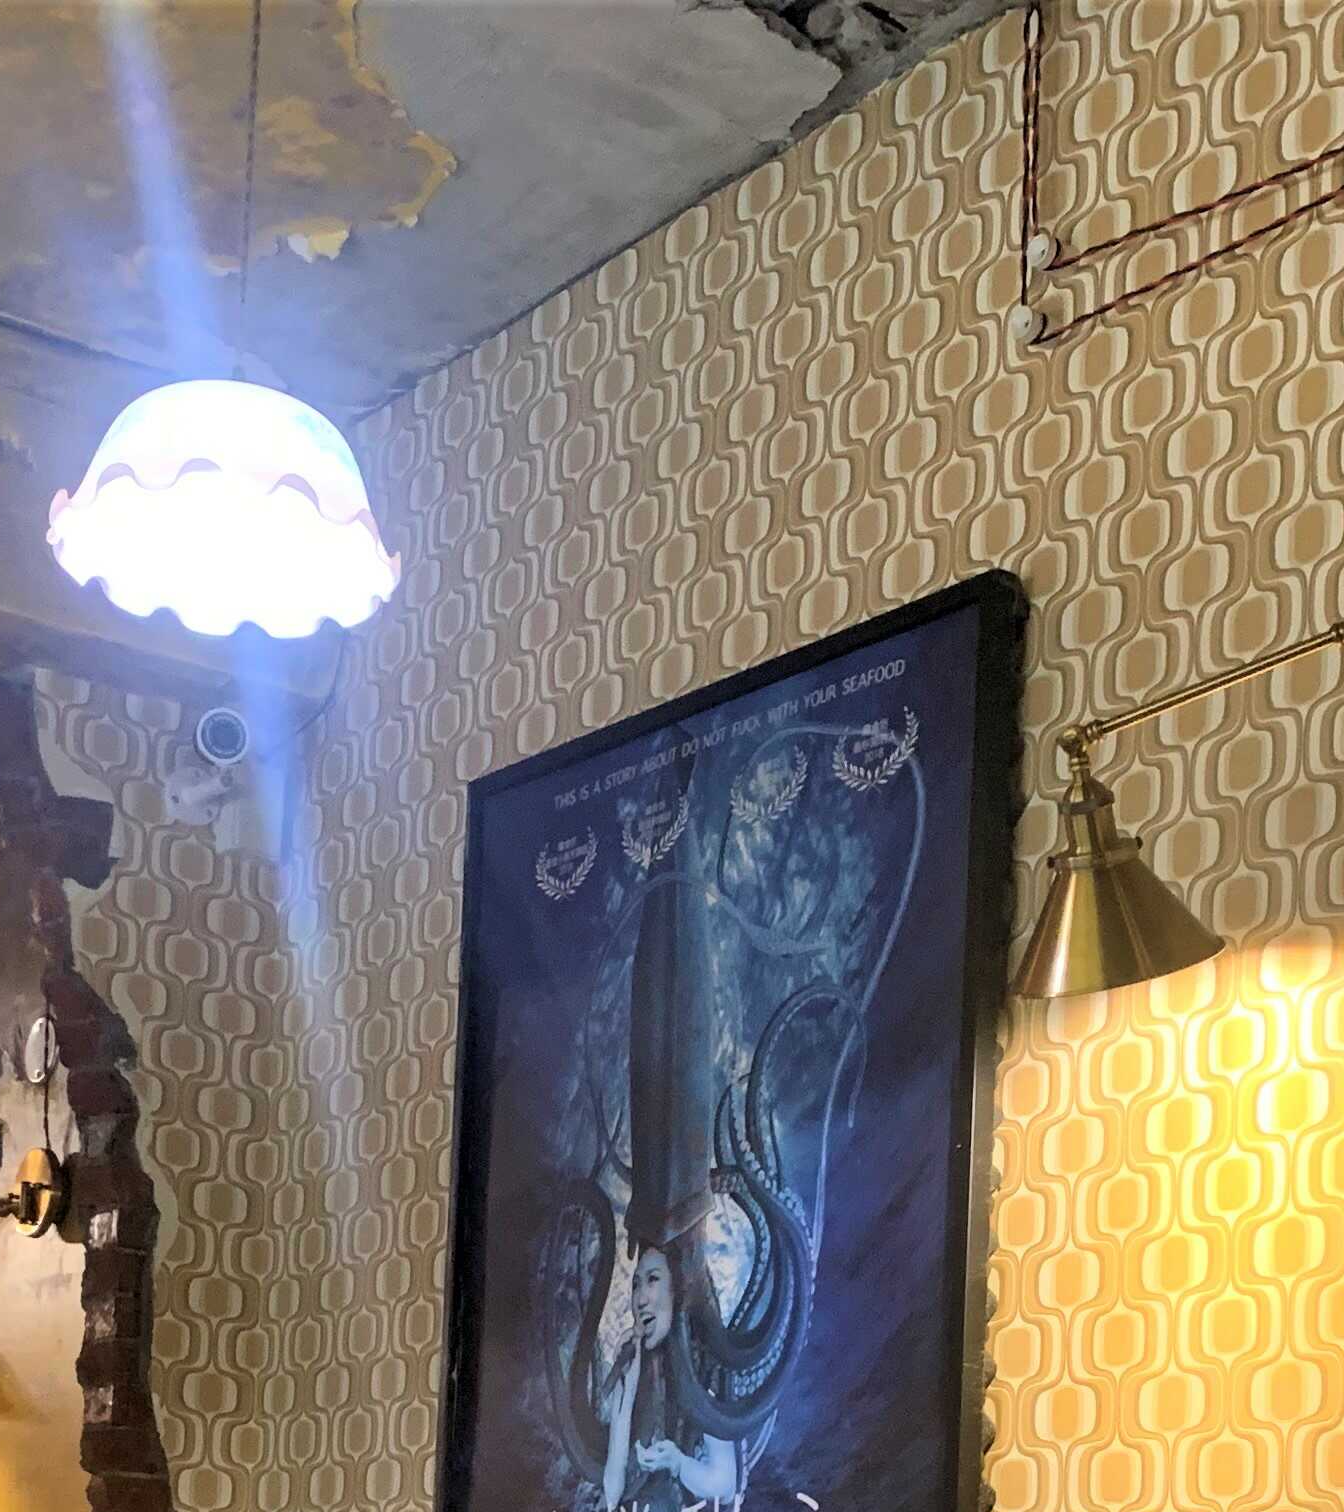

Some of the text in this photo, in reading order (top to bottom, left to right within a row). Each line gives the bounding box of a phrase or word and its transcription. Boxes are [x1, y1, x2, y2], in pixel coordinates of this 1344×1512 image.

[554, 788, 577, 809] THIS
[579, 784, 590, 801] IS
[592, 780, 601, 795] A
[605, 765, 637, 791] STORY
[640, 747, 677, 775] ABOUT
[681, 737, 699, 758] DO
[702, 726, 727, 750] NOT
[767, 700, 799, 724] WITH
[803, 684, 837, 709] YOUR
[841, 658, 906, 696] SEAFOOD
